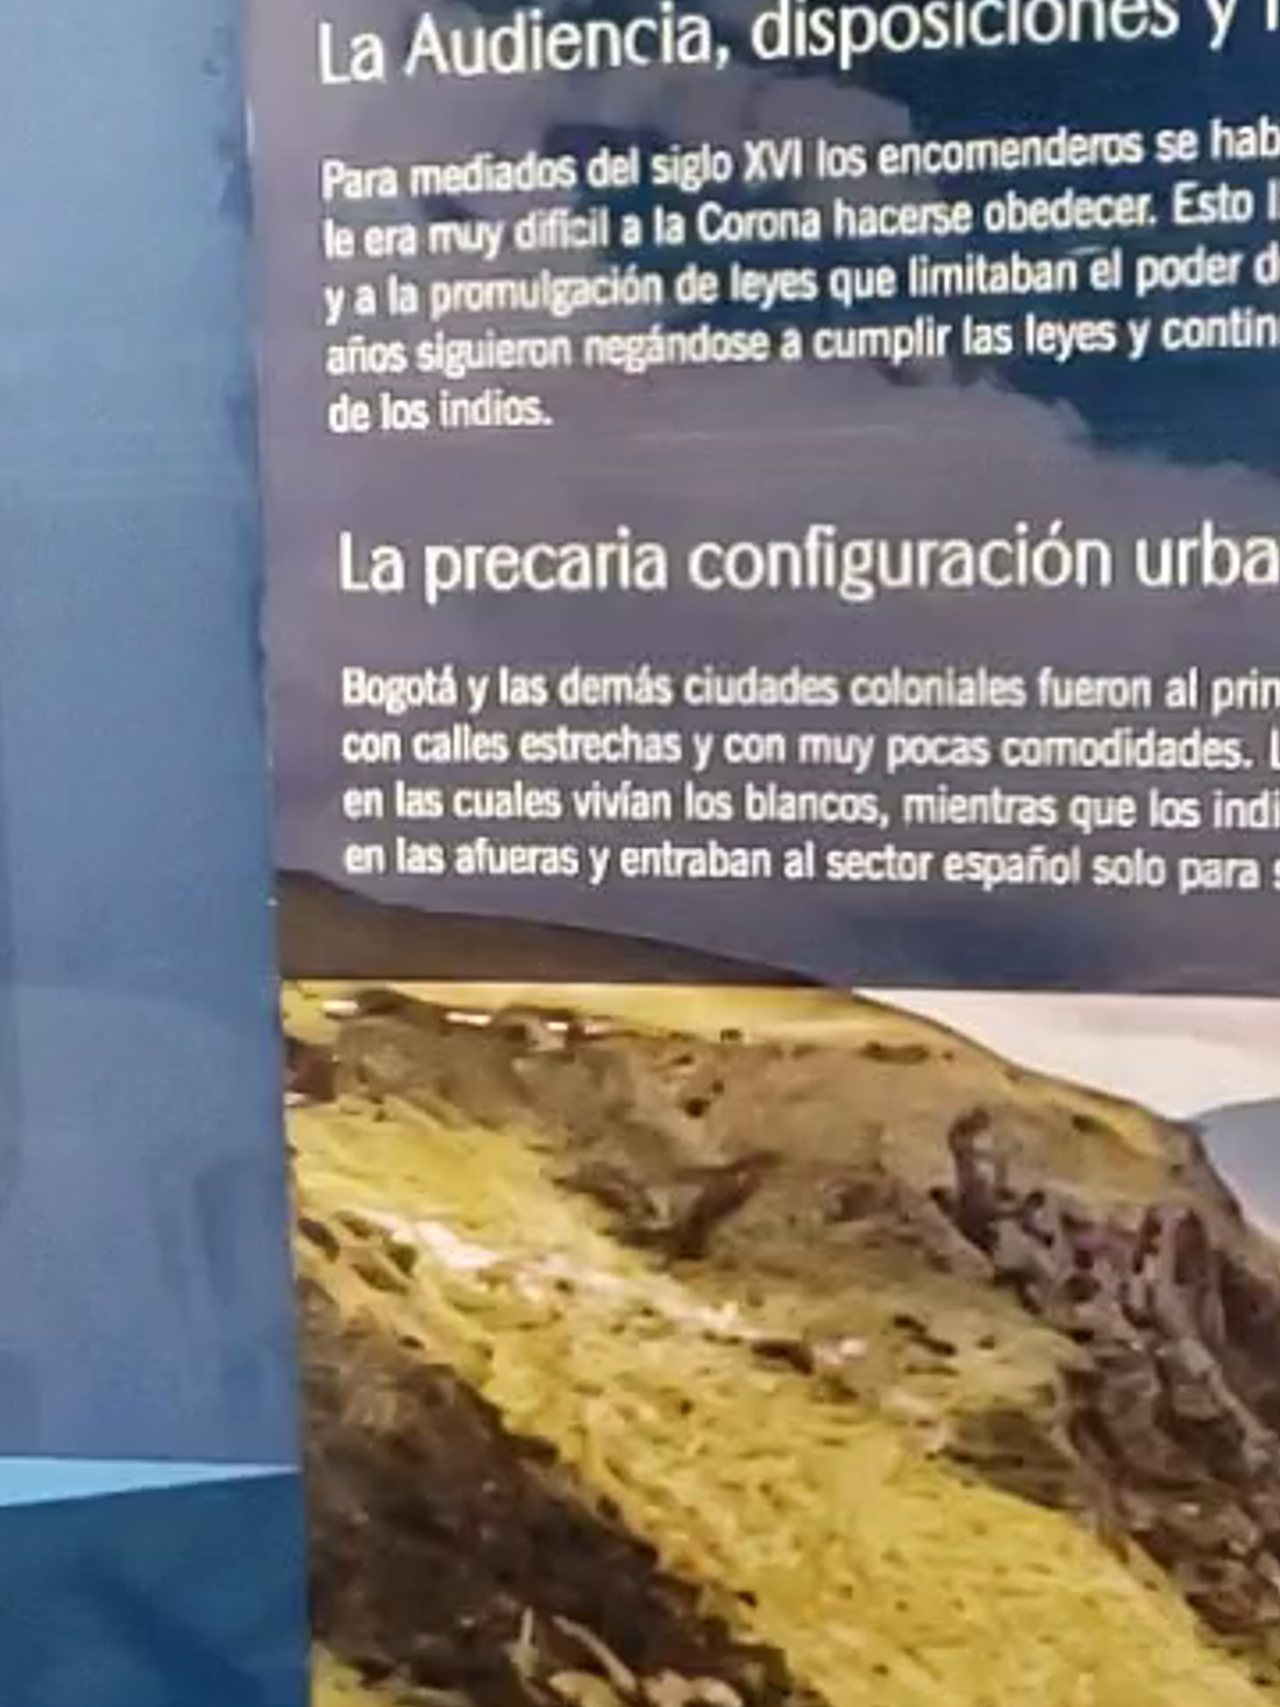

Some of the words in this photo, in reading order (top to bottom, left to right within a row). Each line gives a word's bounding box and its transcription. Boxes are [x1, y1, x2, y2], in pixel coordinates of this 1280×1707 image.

[319, 22, 386, 84] La
[322, 159, 398, 201] Para
[410, 150, 579, 197] mediados
[585, 145, 641, 190] del
[650, 142, 734, 194] siglo
[743, 137, 803, 183] XVI
[816, 137, 868, 180] los
[876, 125, 1147, 178] encomenderos
[1153, 128, 1200, 165] se
[323, 218, 355, 260] le
[364, 223, 418, 257] era
[428, 219, 505, 261] muy
[620, 212, 643, 248] a
[653, 204, 686, 248] la
[695, 200, 822, 246] Corona
[833, 196, 974, 239] hacerse
[983, 186, 1158, 234] obedecer.
[1172, 179, 1255, 226] Esto
[324, 286, 345, 326] y
[354, 283, 377, 317] a
[387, 274, 419, 316] la
[430, 262, 664, 321] promulgación
[673, 262, 720, 306] de
[729, 260, 820, 312] leyes
[827, 264, 898, 310] que
[908, 250, 1079, 298] limitaban
[1088, 246, 1123, 291] el
[1135, 244, 1245, 299] poder
[326, 334, 409, 376] años
[415, 330, 572, 380] siguieron
[583, 322, 770, 374] negándose
[779, 326, 803, 362] a
[812, 314, 953, 367] cumplir
[962, 313, 1014, 356] las
[1024, 311, 1119, 363] leyes
[1126, 317, 1152, 362] y
[328, 392, 372, 434] de
[379, 391, 430, 431] los
[439, 388, 553, 428] indios.
[339, 531, 405, 593] La
[424, 525, 668, 606] precaria
[688, 519, 1112, 603] configuración
[342, 664, 458, 716] Bogotá
[467, 675, 490, 715] y
[499, 665, 549, 707] las
[557, 663, 674, 706] demás
[683, 665, 840, 707] ciudades
[849, 666, 1028, 708] coloniales
[1037, 666, 1152, 708] fueron
[1164, 666, 1198, 709] al
[341, 731, 402, 764] con
[411, 722, 511, 764] calles
[518, 723, 683, 763] estrechas
[692, 732, 715, 773] y
[723, 732, 786, 764] con
[797, 733, 875, 775] muy
[886, 733, 992, 775] pocas
[1000, 726, 1254, 771] comodidades.
[342, 787, 384, 820] en
[395, 779, 444, 819] las
[452, 779, 563, 820] cuales
[571, 779, 672, 821] vivían
[684, 780, 735, 821] los
[744, 781, 890, 830] blancos,
[902, 783, 1059, 827] mientras
[1068, 794, 1138, 835] que
[1148, 787, 1202, 829] los
[343, 843, 385, 874] en
[395, 835, 447, 875] las
[454, 836, 580, 877] afueras
[588, 846, 611, 886] y
[619, 838, 772, 878] entraban
[783, 839, 816, 880] al
[825, 843, 935, 882] sector
[942, 844, 1082, 893] español
[1091, 846, 1167, 888] solo
[1177, 857, 1261, 895] para
